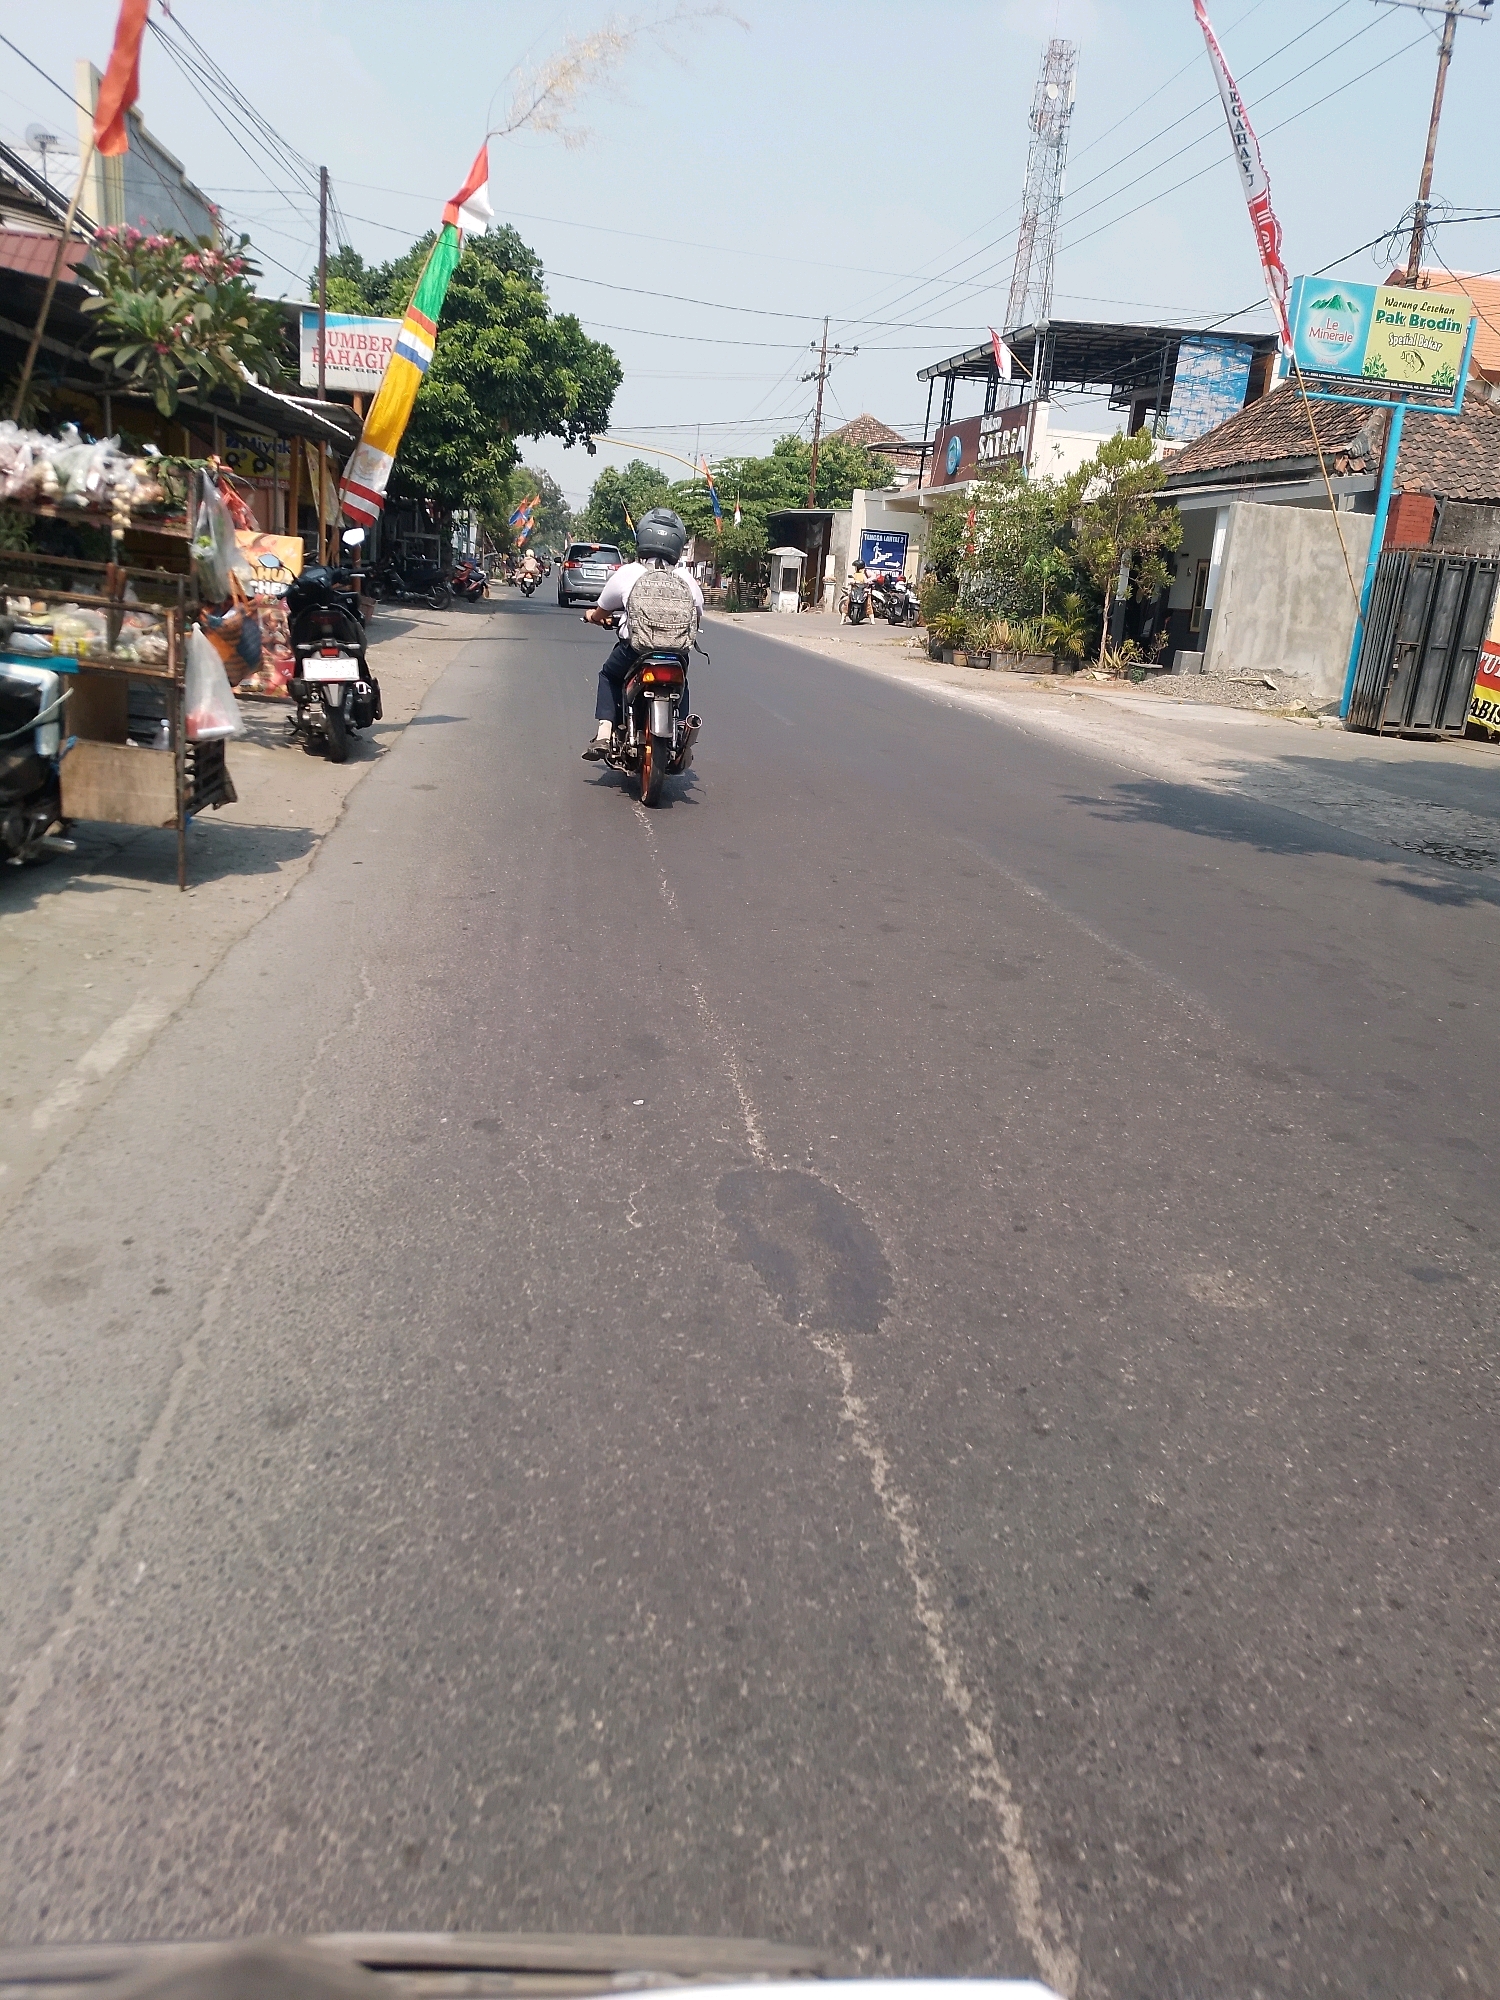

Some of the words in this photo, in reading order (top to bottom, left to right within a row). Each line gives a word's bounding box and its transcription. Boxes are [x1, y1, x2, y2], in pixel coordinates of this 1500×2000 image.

[1385, 296, 1419, 313] Warung
[1420, 301, 1456, 315] Lesehan
[1326, 317, 1339, 331] Le
[1375, 309, 1407, 327] Pak
[1408, 313, 1462, 334] Brodin
[316, 330, 393, 353] UMBER
[1309, 326, 1354, 343] Minerale
[1418, 334, 1443, 352] Bakar
[978, 425, 1026, 461] SATRIA
